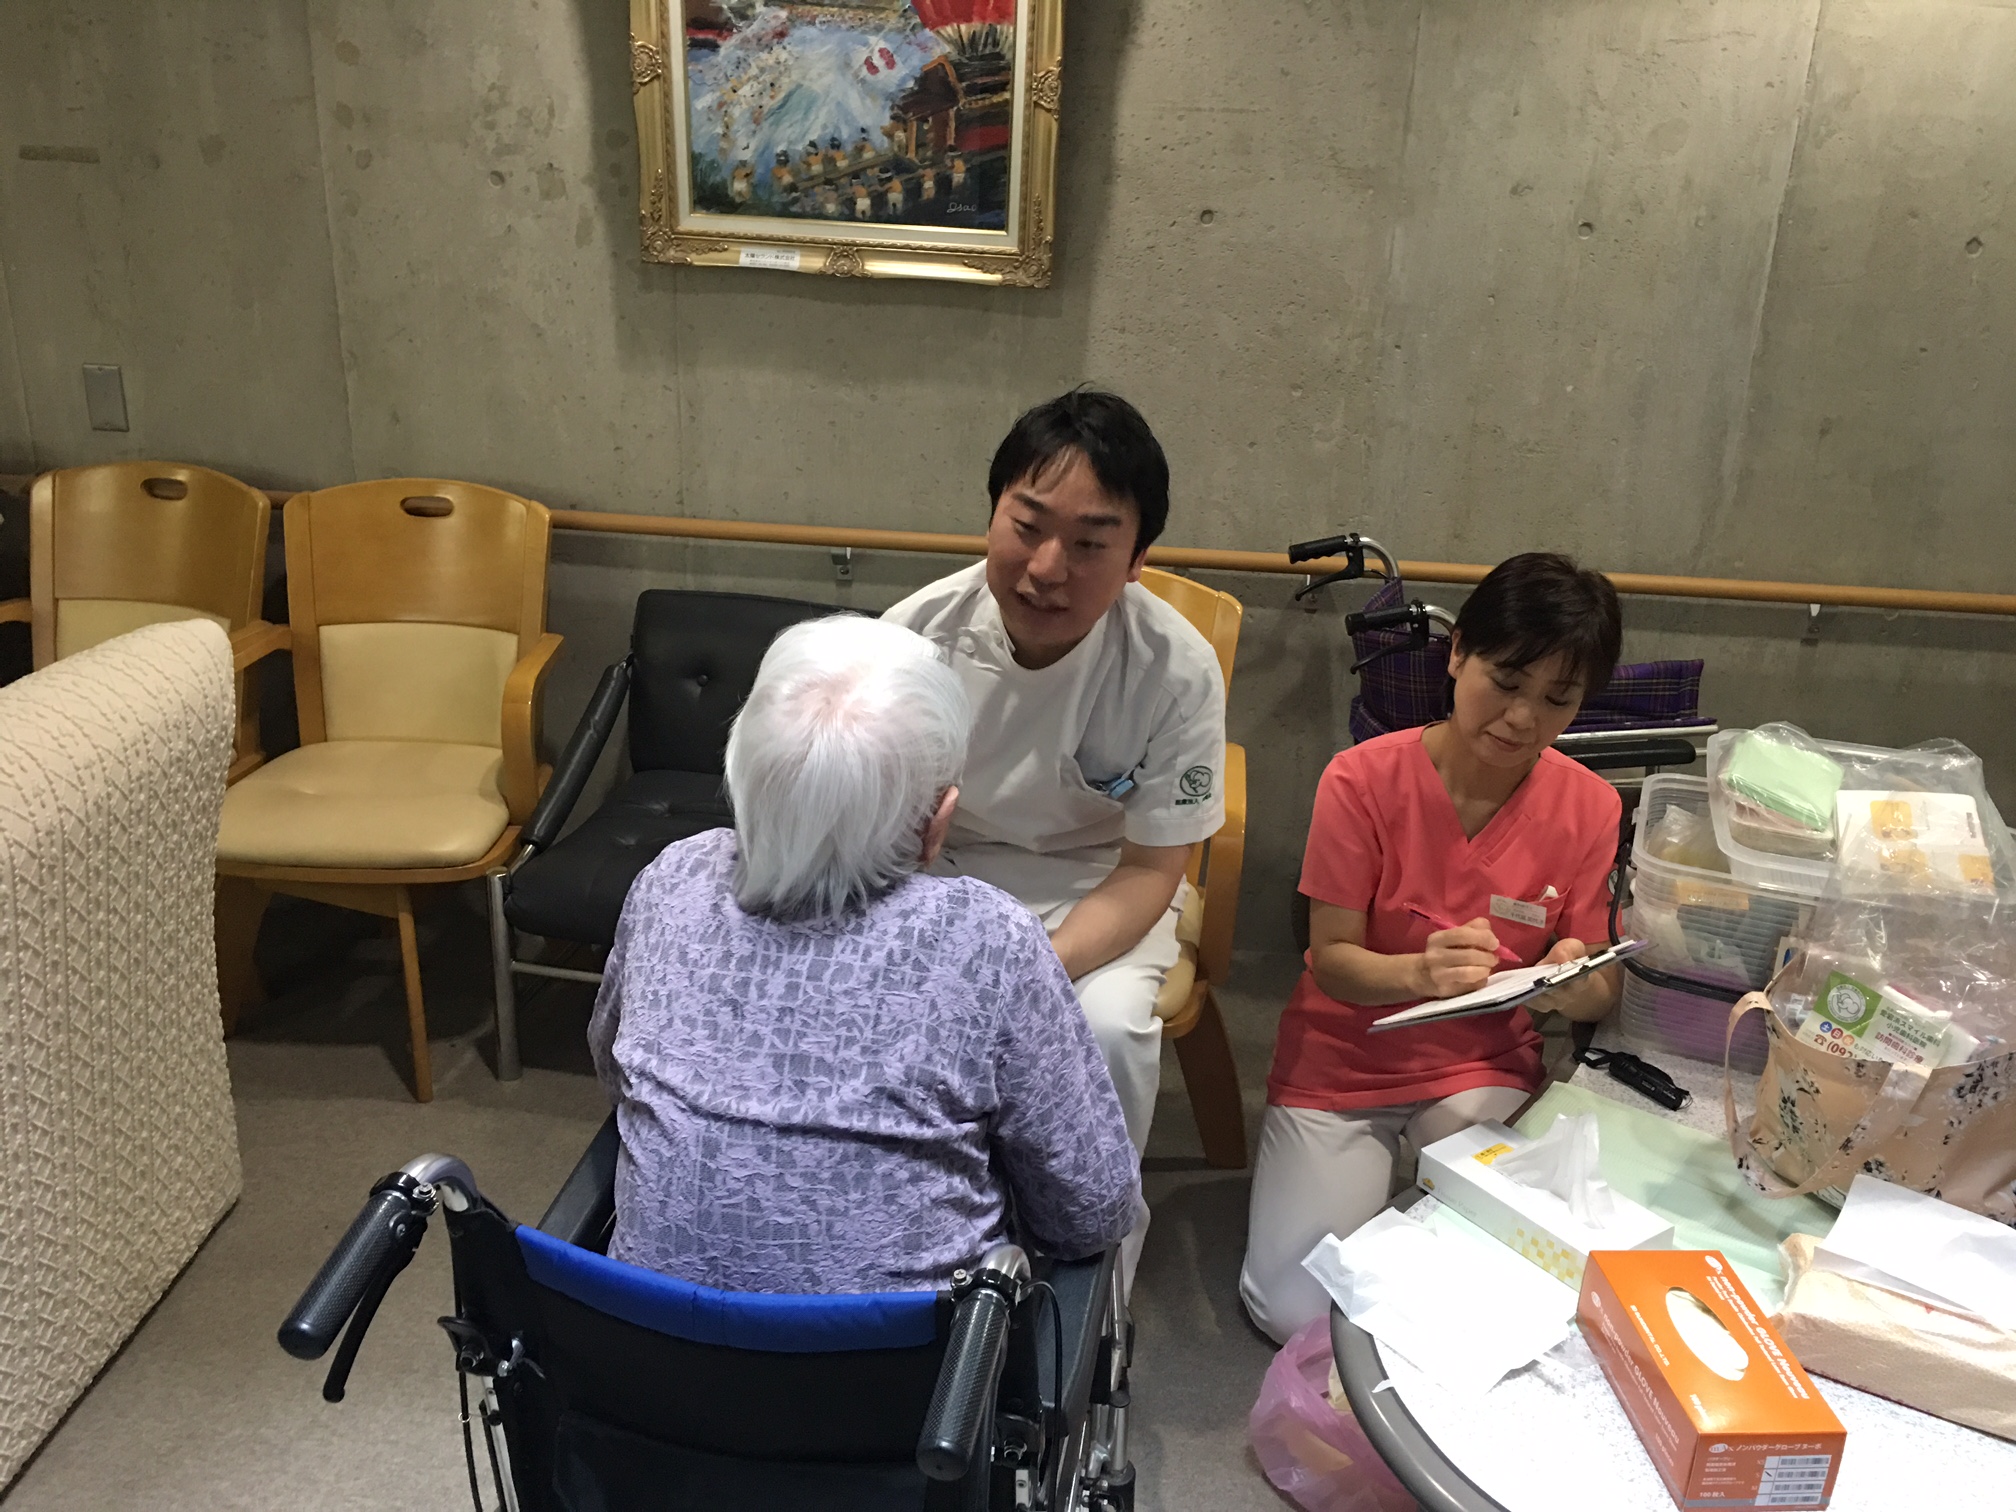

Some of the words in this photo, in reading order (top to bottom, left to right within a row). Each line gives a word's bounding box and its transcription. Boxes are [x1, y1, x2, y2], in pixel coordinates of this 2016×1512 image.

[1875, 1031, 1924, 1064] 訪問歯科診療
[1720, 1276, 1760, 1326] non-powder
[1756, 1327, 1783, 1356] GLOVE
[1777, 1358, 1810, 1399] Nouveau
[1603, 1310, 1635, 1367] non-powder
[1634, 1365, 1653, 1400] GLOVE
[1652, 1396, 1680, 1445] Nouveau
[1736, 1443, 1801, 1452] ノンパウダーグローブ
